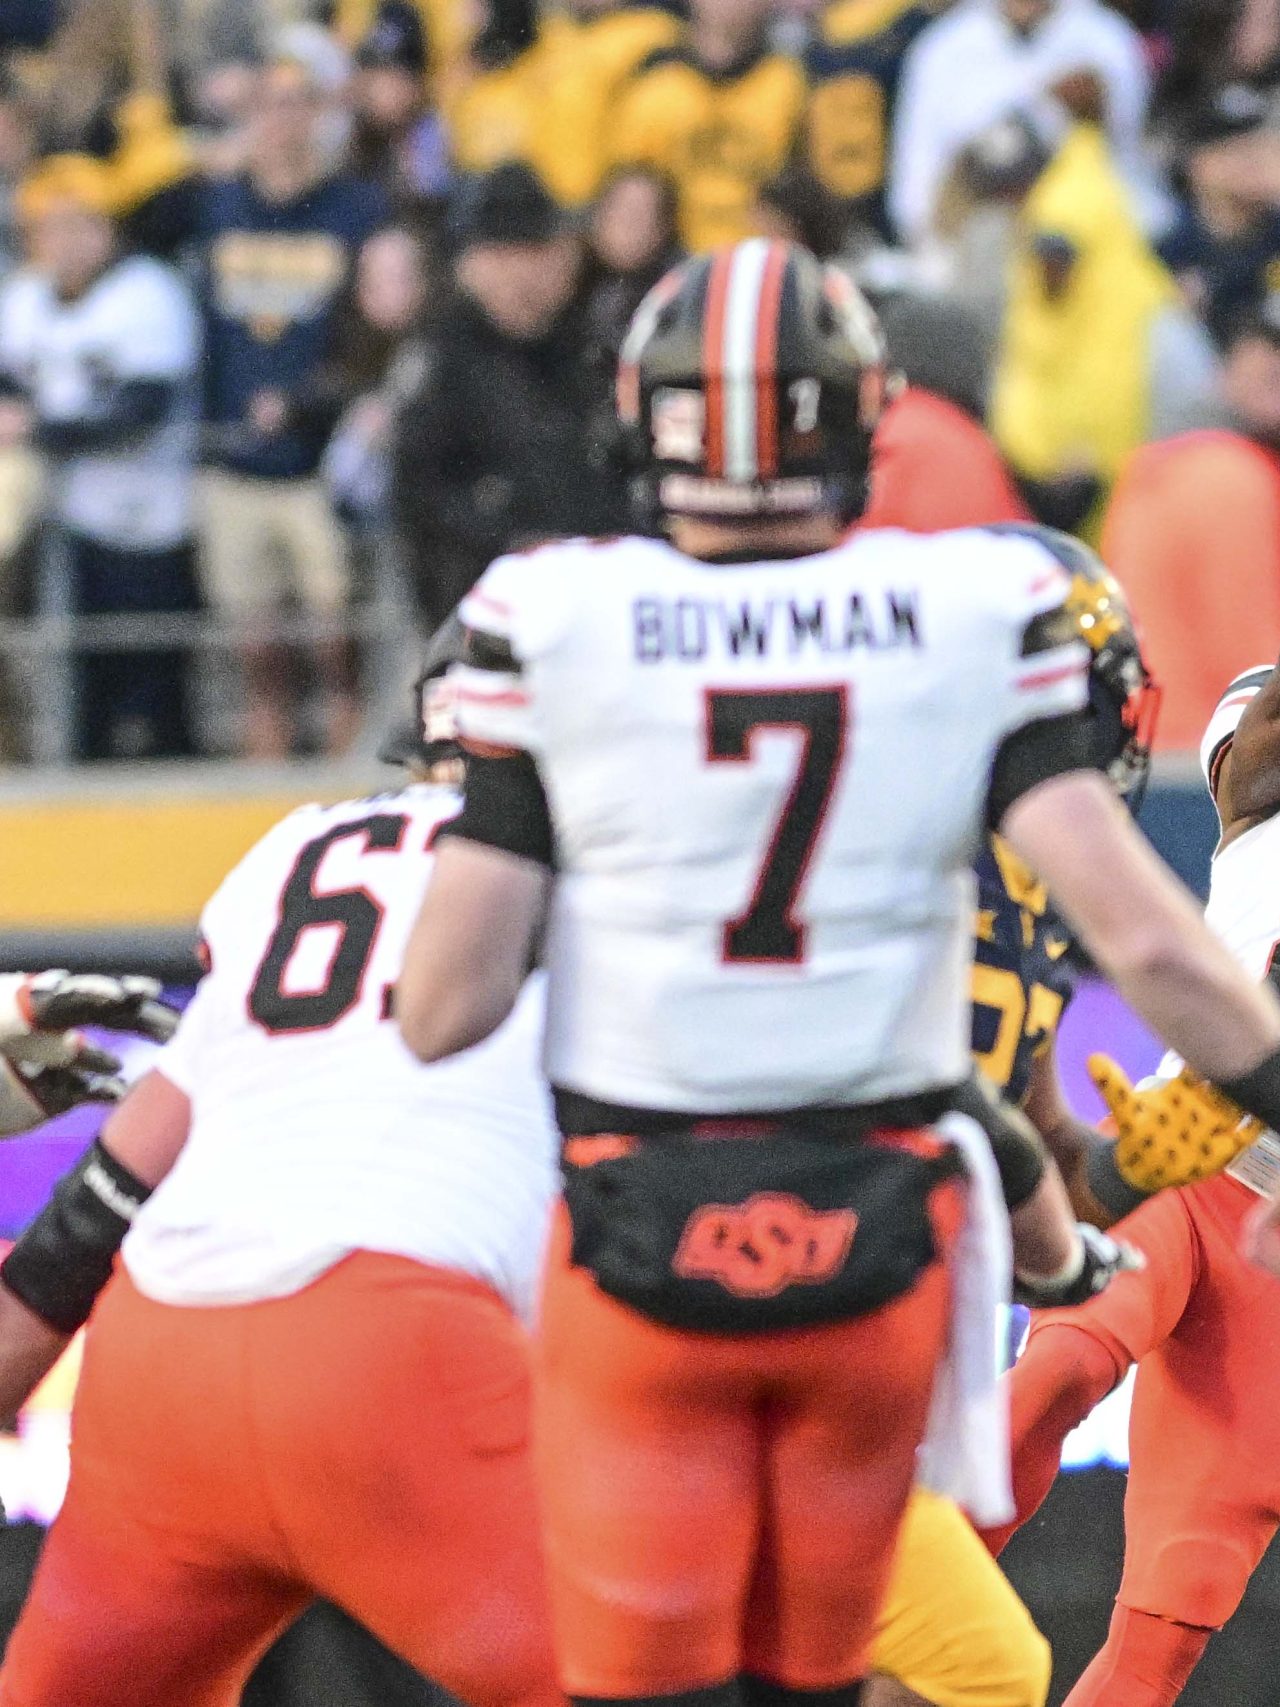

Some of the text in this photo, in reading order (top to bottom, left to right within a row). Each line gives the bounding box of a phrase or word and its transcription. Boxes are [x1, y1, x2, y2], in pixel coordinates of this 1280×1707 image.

[633, 586, 925, 664] BOWMAN
[246, 813, 458, 1037] 6
[703, 685, 850, 963] 7
